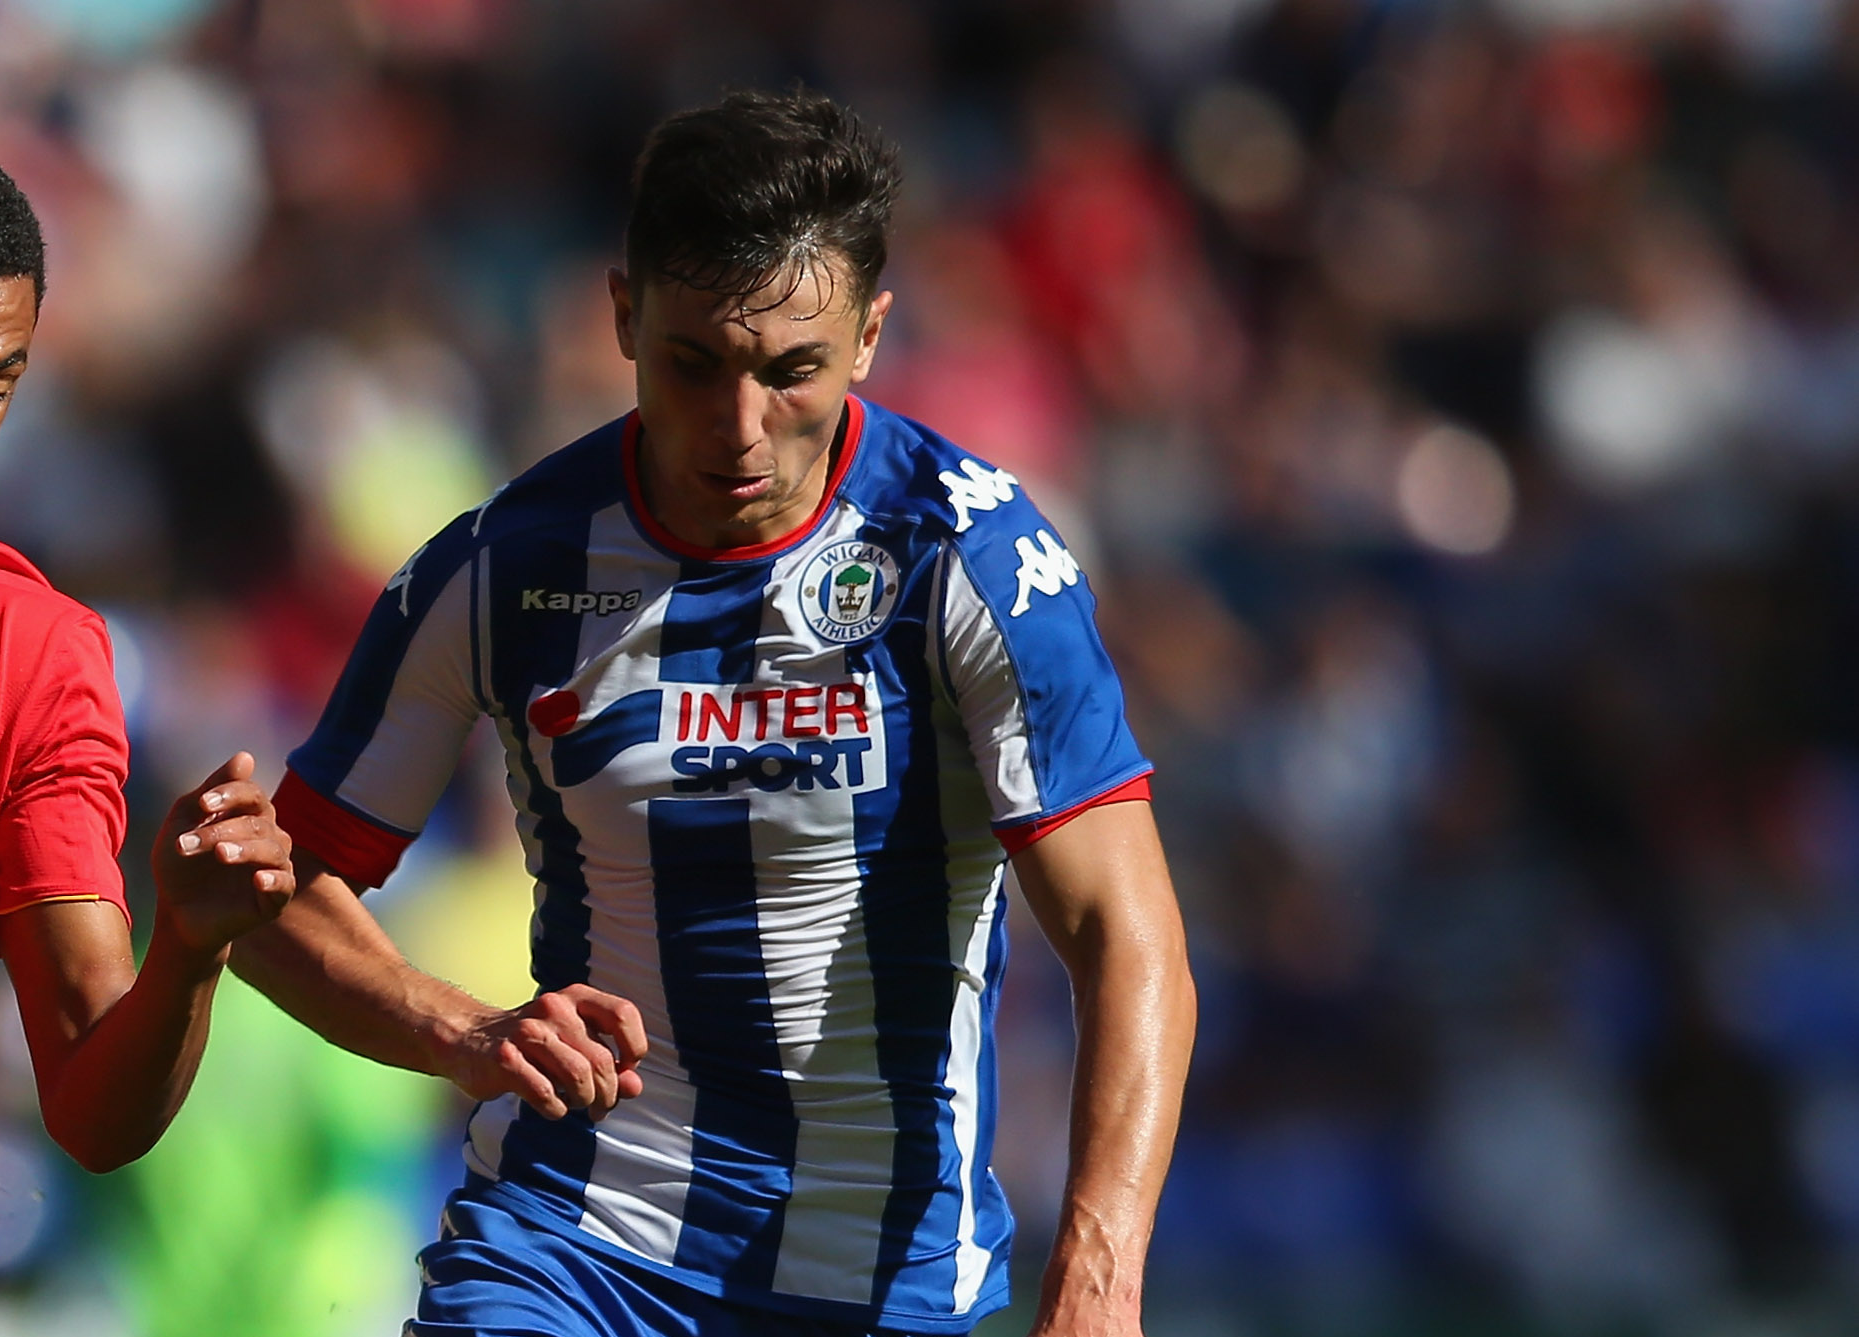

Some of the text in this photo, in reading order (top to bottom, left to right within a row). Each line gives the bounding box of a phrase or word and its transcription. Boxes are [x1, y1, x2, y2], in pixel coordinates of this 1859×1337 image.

[820, 544, 889, 567] WIGAN
[521, 588, 640, 615] Kappa
[812, 613, 882, 640] ATHLETIC
[677, 682, 869, 742] INTER
[670, 737, 872, 793] SPORT
